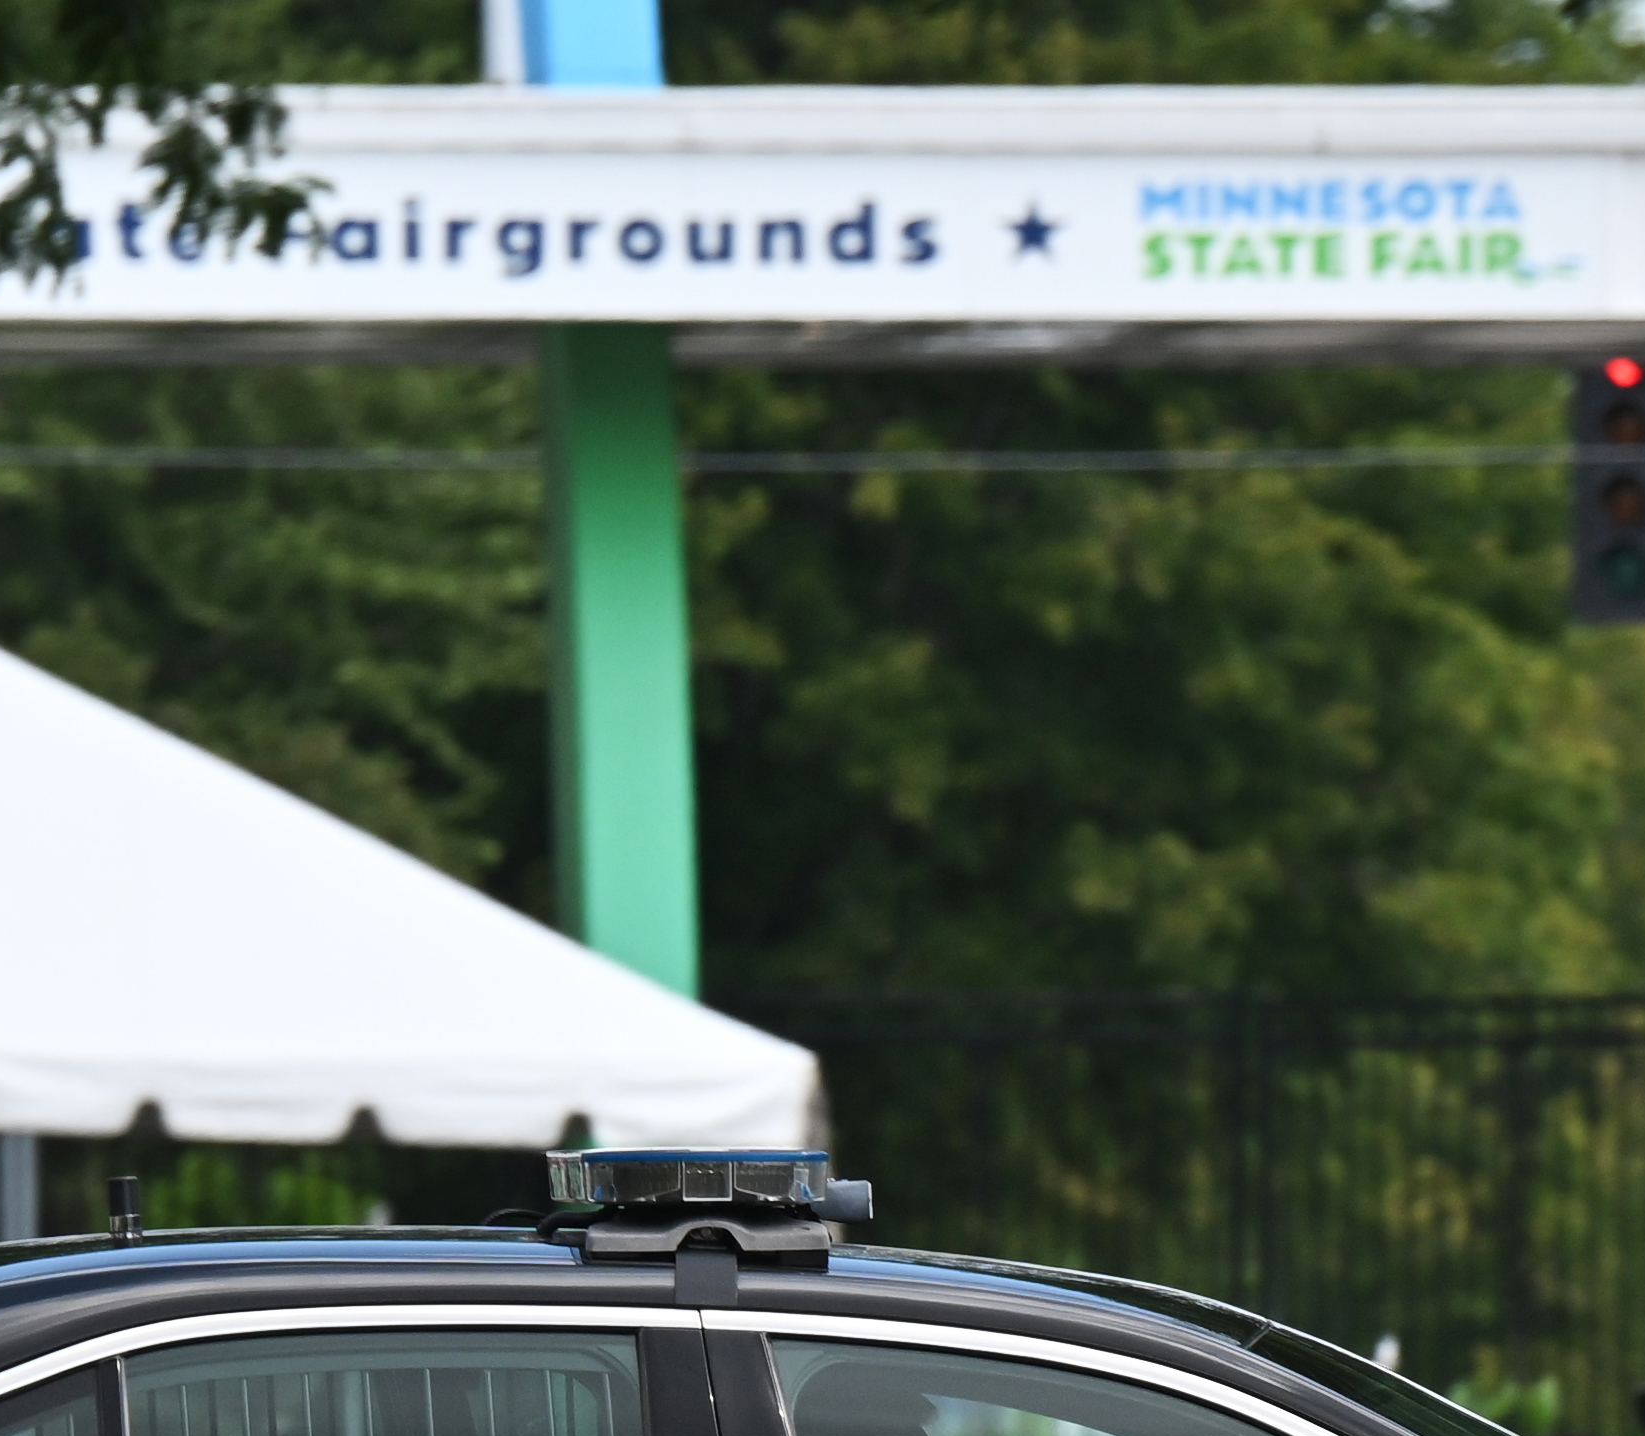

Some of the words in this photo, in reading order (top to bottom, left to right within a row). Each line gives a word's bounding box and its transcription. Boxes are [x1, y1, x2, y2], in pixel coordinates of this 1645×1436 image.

[1139, 178, 1520, 222] MINNESOTA
[266, 196, 940, 276] airgrounds
[1142, 230, 1344, 279] STATE
[1368, 230, 1556, 284] FAIR
